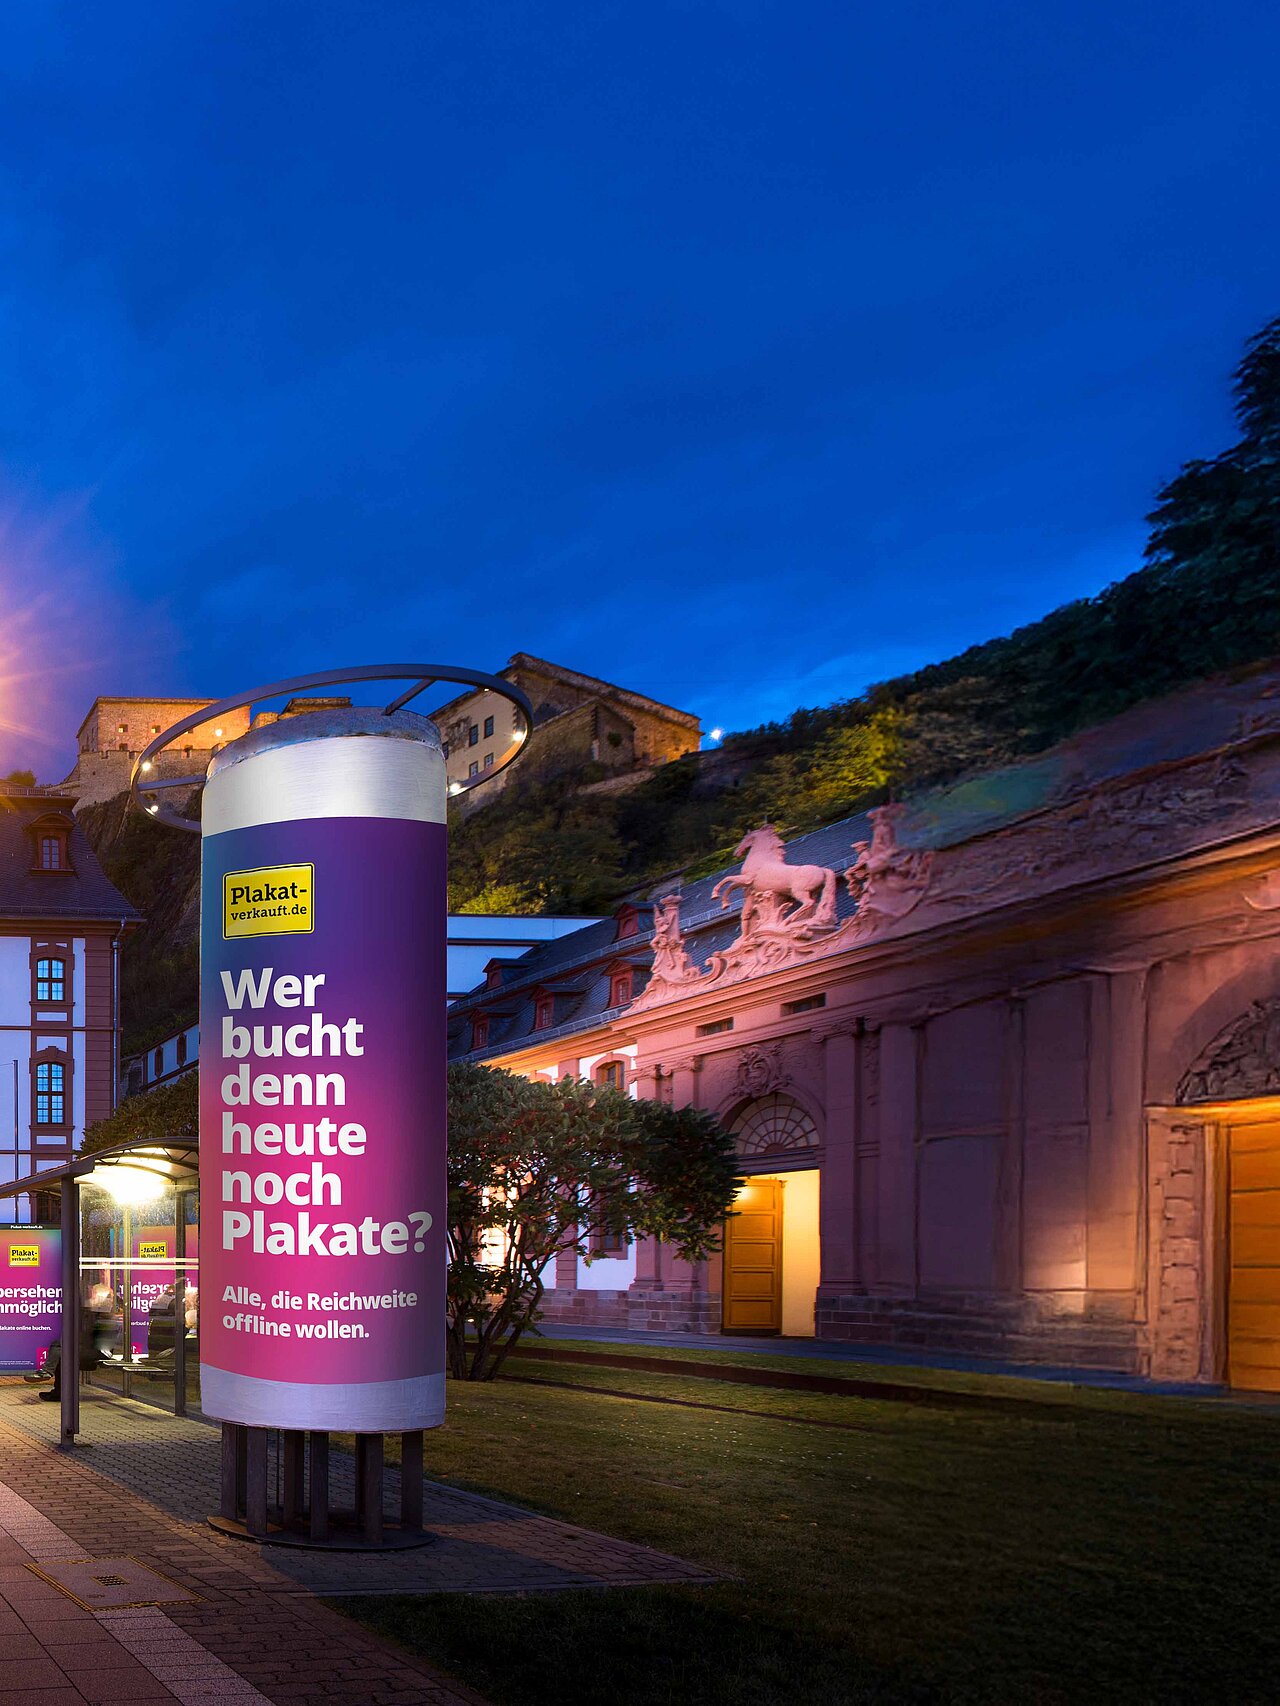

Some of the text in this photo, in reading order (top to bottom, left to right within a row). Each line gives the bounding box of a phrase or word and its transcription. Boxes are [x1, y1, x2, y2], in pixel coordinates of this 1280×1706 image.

[230, 882, 307, 905] Plakat-
[230, 904, 307, 921] verkauft.de
[220, 967, 325, 1010] Wer
[222, 1013, 364, 1058] bucht
[221, 1064, 346, 1106] denn
[222, 1111, 367, 1156] heute
[222, 1162, 342, 1206] noch
[11, 1249, 38, 1257] Plakat-
[222, 1210, 433, 1256] Plakate?
[222, 1285, 418, 1311] Alle, die Reichweite
[222, 1312, 370, 1339] offline wollen.
